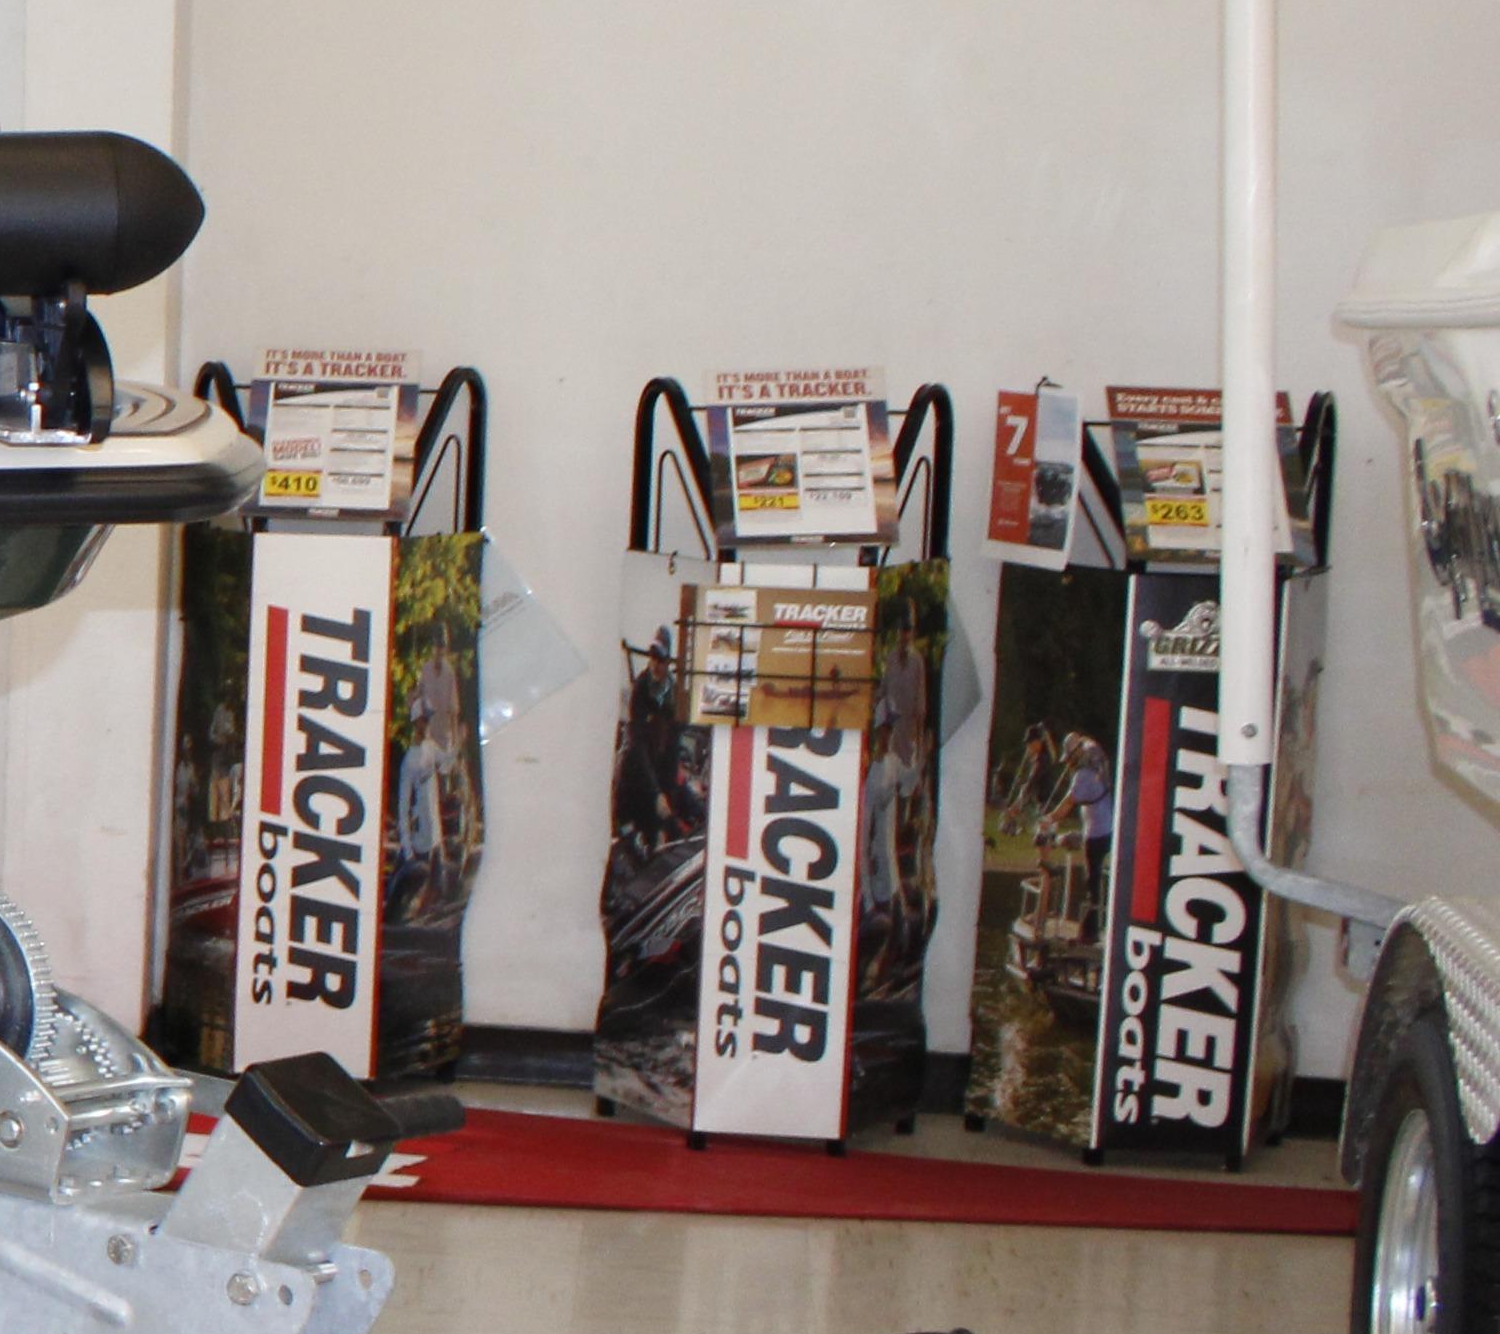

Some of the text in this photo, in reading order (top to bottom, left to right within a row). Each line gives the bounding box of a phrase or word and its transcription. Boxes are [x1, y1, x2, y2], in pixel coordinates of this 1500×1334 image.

[264, 361, 298, 375] IT'S
[302, 362, 314, 376] A
[717, 385, 755, 400] IT'S
[759, 383, 771, 399] A
[1005, 415, 1029, 456] 7
[271, 475, 318, 492] $410
[1150, 500, 1204, 521] $263
[773, 603, 868, 622] TRACKER
[286, 608, 372, 1011] TRACKER
[251, 820, 288, 1005] boats
[715, 864, 755, 1059] boats
[1113, 926, 1161, 1125] boats
